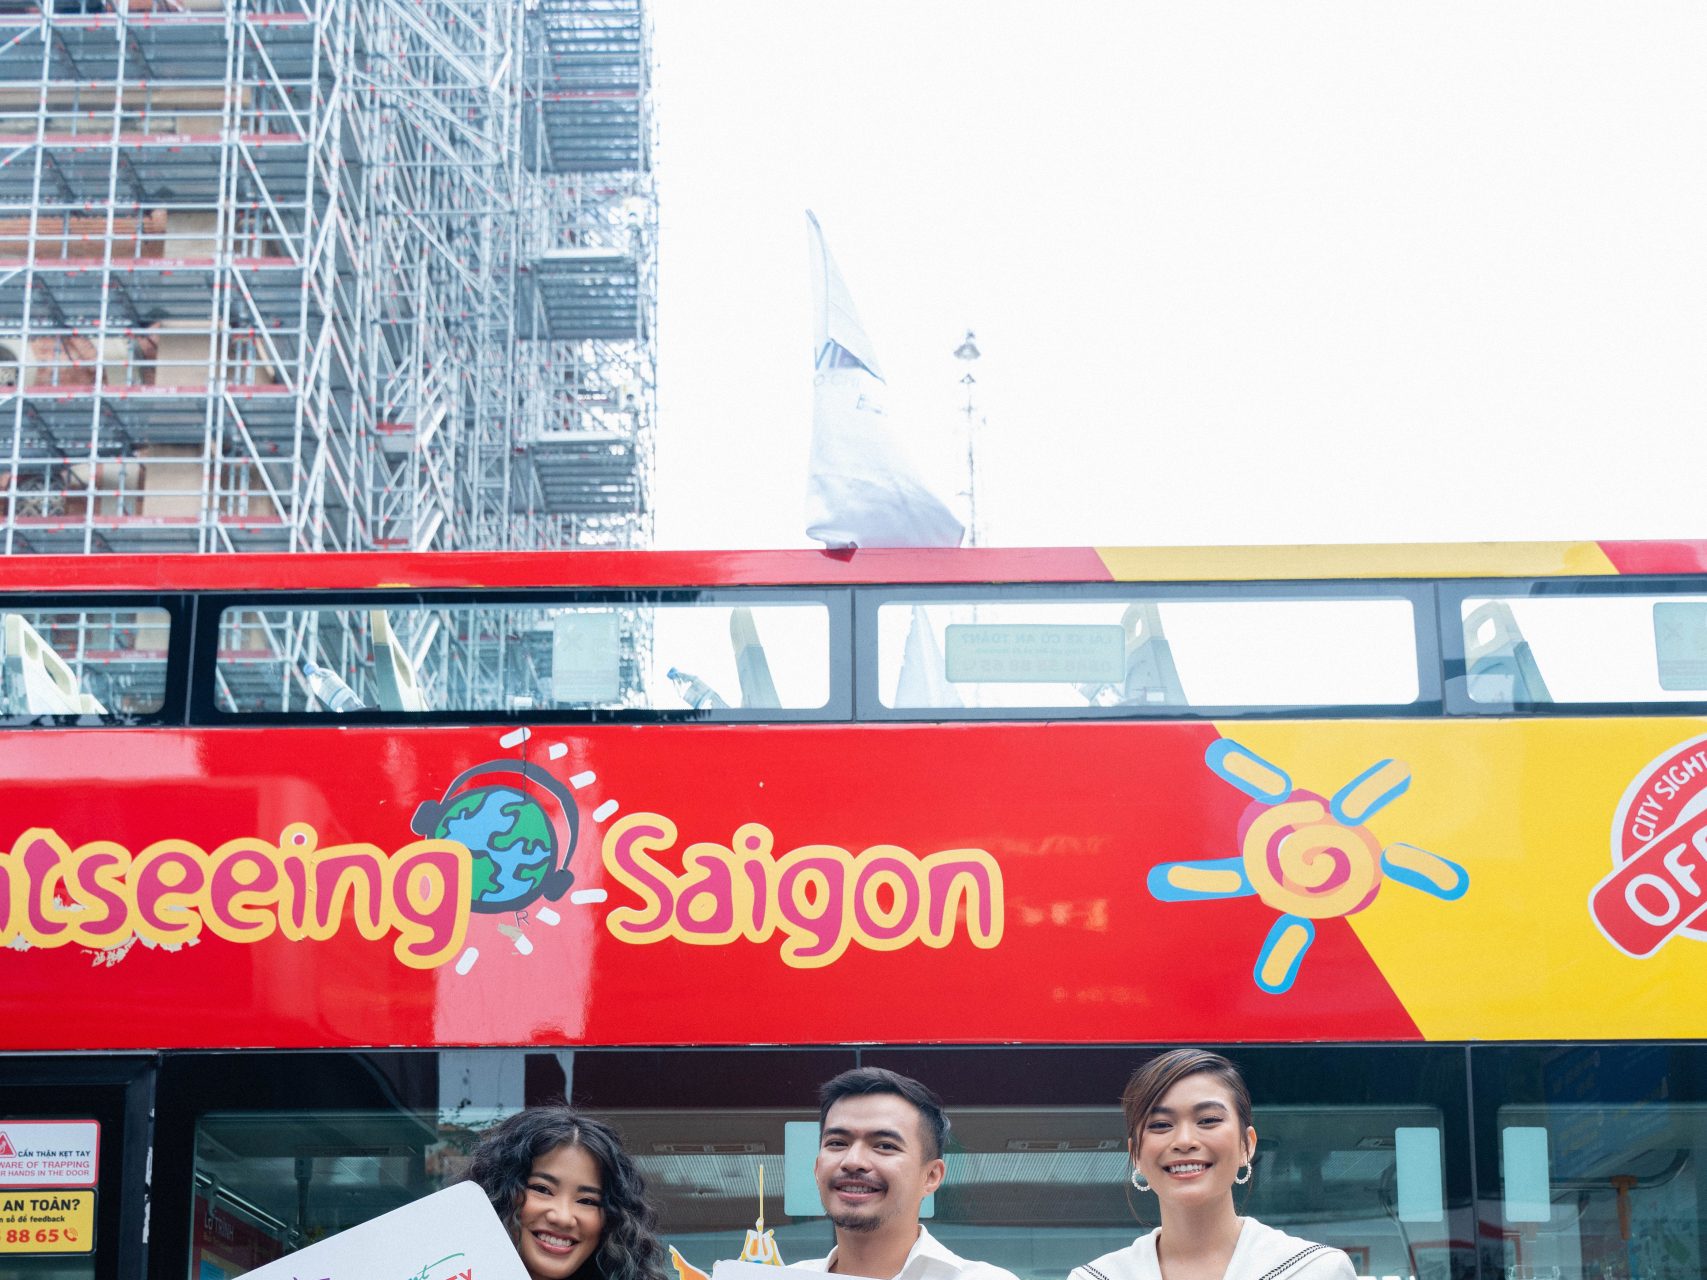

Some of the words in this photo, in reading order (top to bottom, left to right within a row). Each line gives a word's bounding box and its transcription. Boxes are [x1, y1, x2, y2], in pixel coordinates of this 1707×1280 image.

[1632, 794, 1664, 842] CITY
[602, 812, 1004, 969] Saigon
[42, 1160, 90, 1168] TRAPPING
[3, 1199, 24, 1212] AN
[30, 1196, 81, 1211] TOÀN?
[30, 1215, 65, 1223] feedback
[6, 1229, 31, 1244] 88
[35, 1228, 59, 1243] 65
